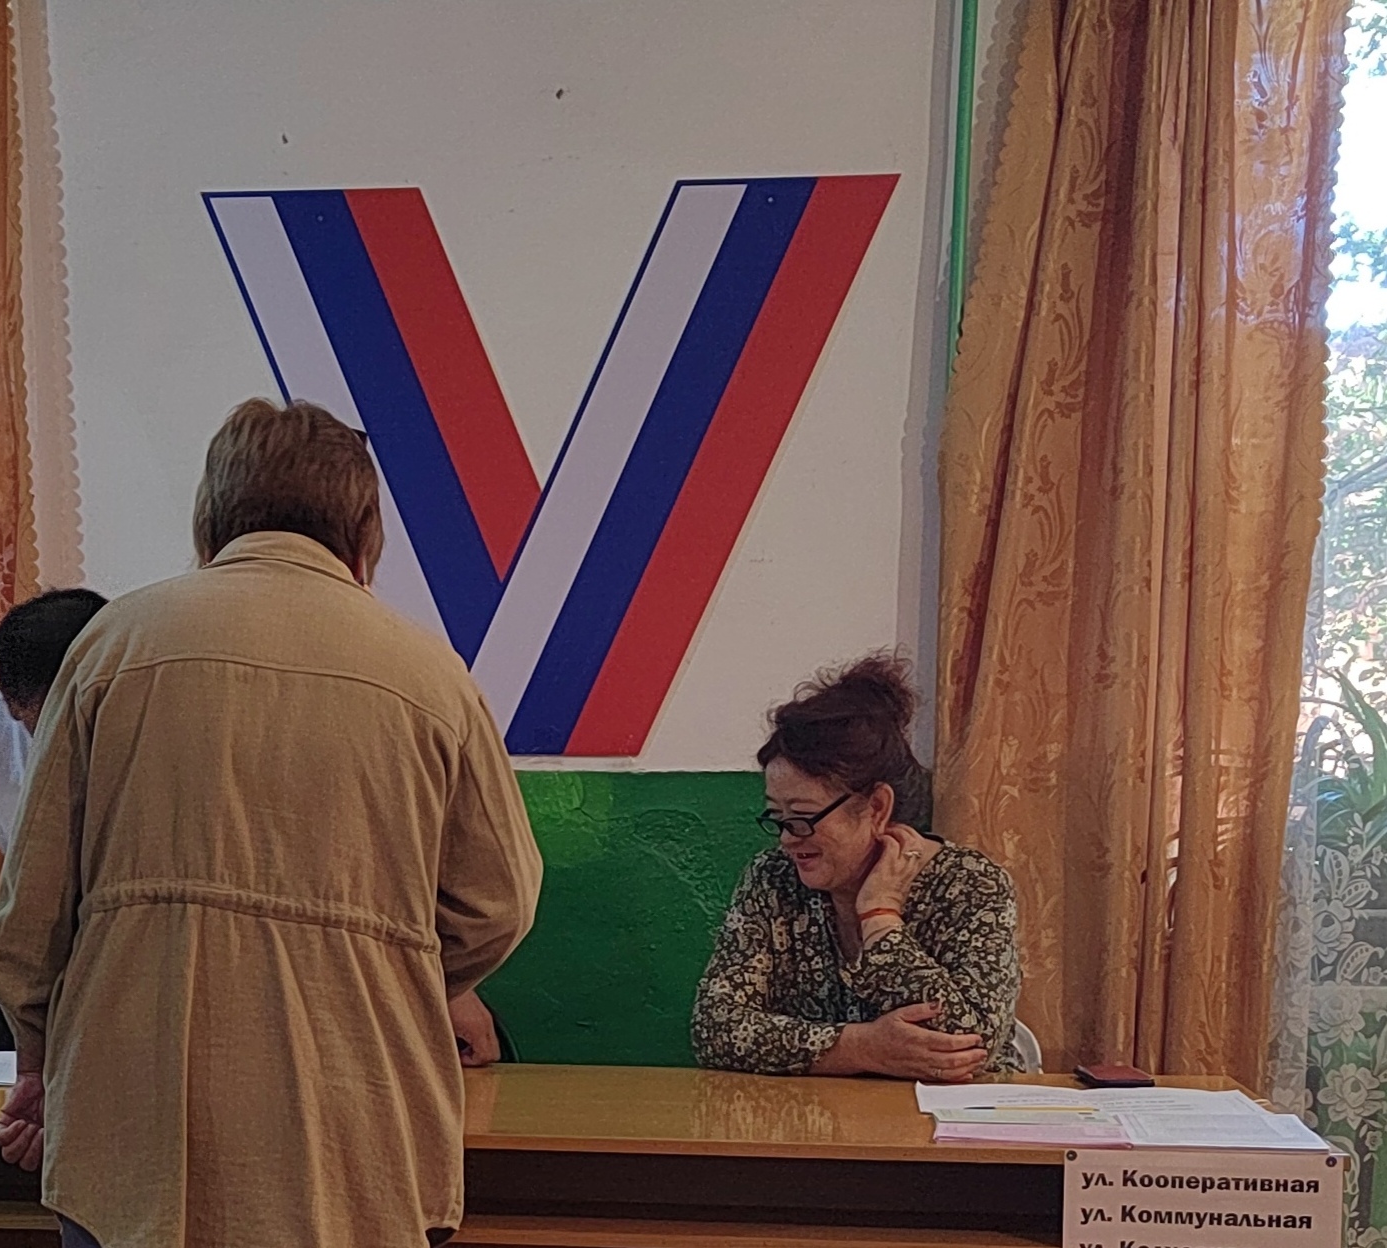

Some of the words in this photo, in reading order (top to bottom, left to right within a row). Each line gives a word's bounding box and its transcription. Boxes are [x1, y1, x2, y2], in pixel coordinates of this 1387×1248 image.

[1081, 1172, 1114, 1190] ул.
[1122, 1169, 1320, 1194] Кооперативная
[1080, 1207, 1113, 1226] ул.
[1120, 1204, 1313, 1230] Коммунальная
